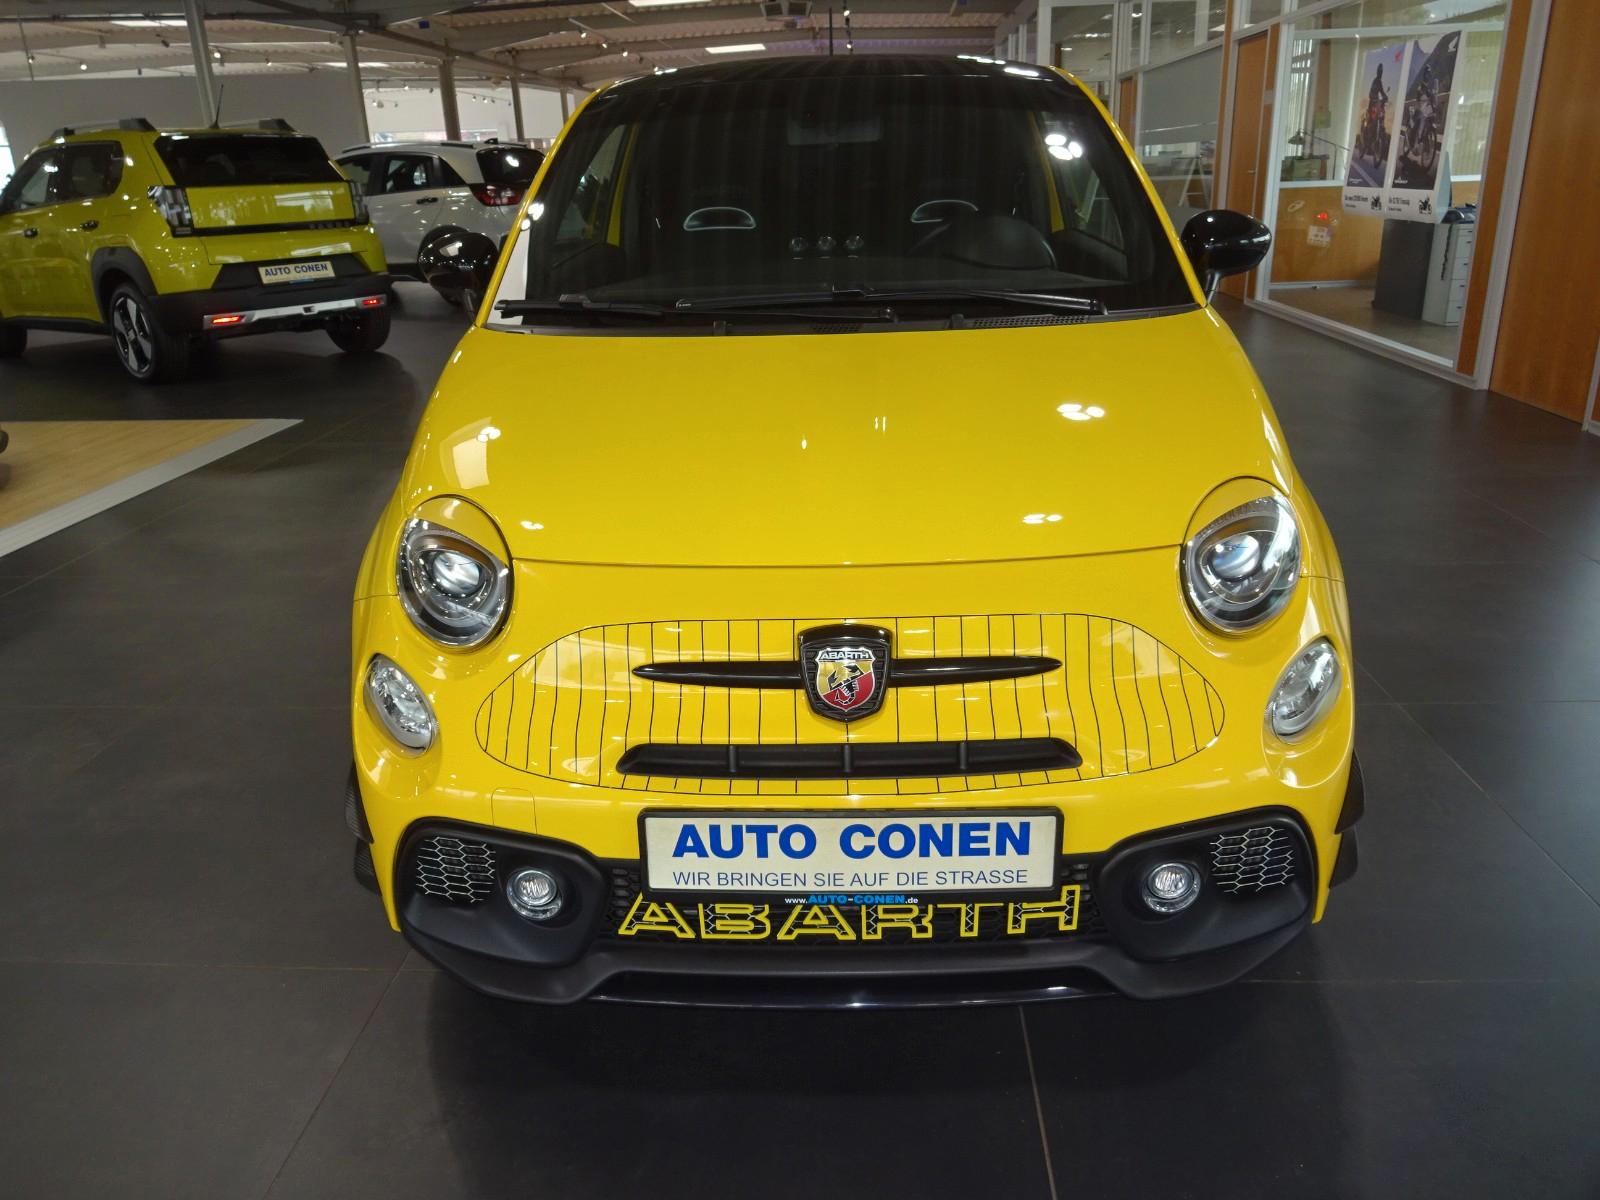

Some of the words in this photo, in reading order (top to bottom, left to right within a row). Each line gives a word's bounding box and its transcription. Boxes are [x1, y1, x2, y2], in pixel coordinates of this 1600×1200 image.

[265, 267, 291, 276] AUTO
[294, 264, 328, 273] CONEN
[821, 651, 869, 659] ABARTH
[672, 824, 817, 859] AUTO
[839, 821, 1031, 859] CONEN
[673, 871, 711, 887] WIR
[717, 872, 808, 887] BRINGEN
[814, 872, 845, 888] SIE
[850, 872, 890, 887] AUF
[896, 871, 929, 886] DIE
[935, 869, 1028, 885] STRASSE
[784, 894, 919, 905] www.AUTO-CONEN.de
[618, 884, 1081, 940] ABARTH
